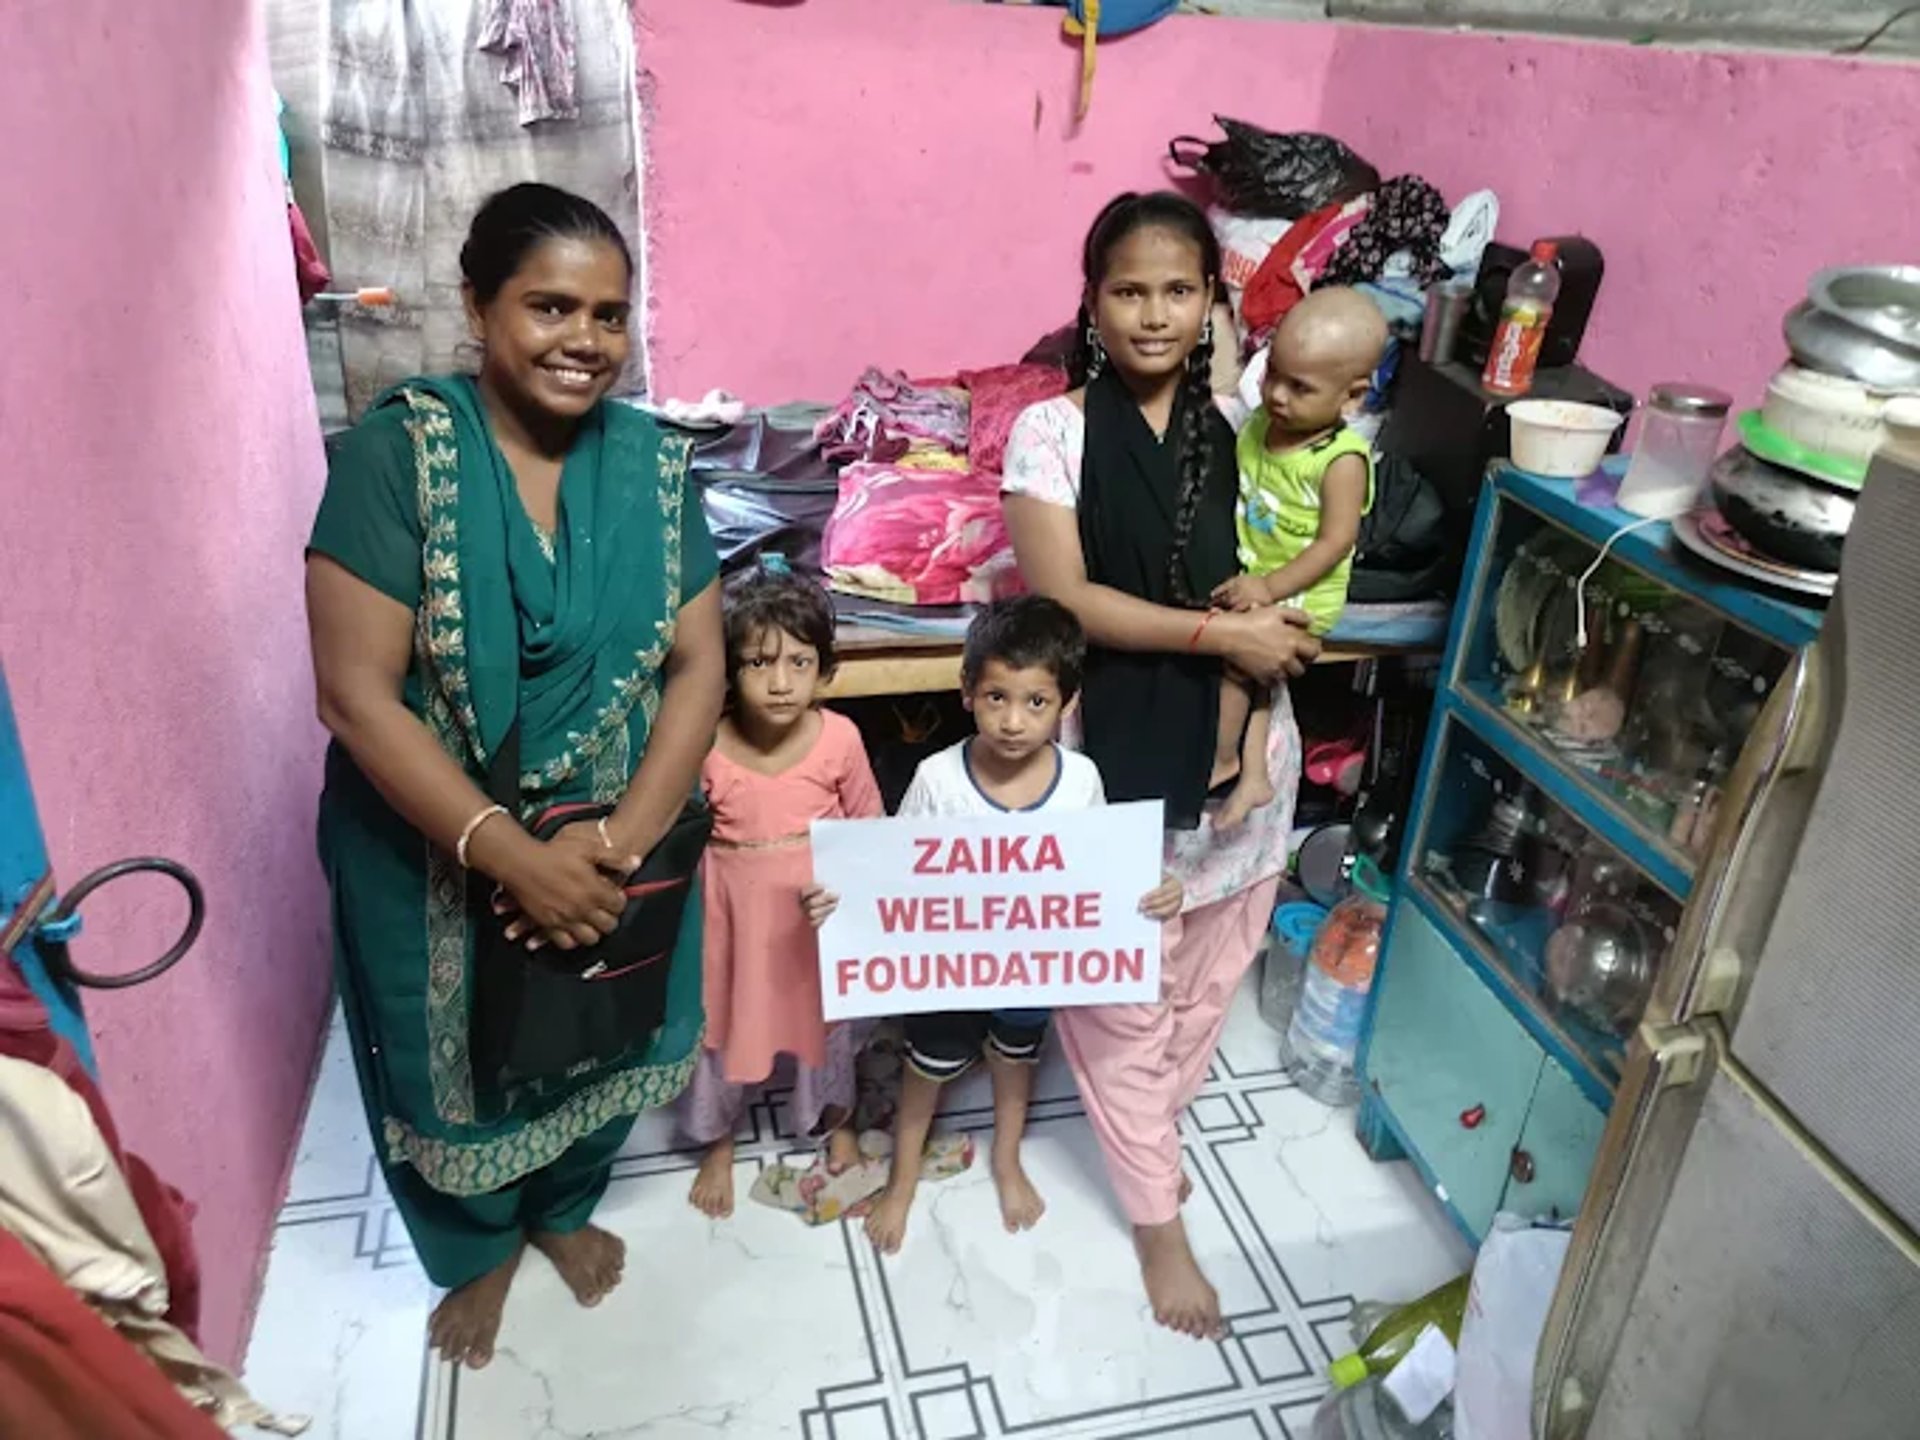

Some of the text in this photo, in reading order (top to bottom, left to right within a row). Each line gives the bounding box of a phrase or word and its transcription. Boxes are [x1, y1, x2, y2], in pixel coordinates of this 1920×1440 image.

[913, 834, 1065, 875] ZAIKA
[878, 892, 1101, 933] WELFARE
[836, 948, 1144, 996] FOUNDATION
